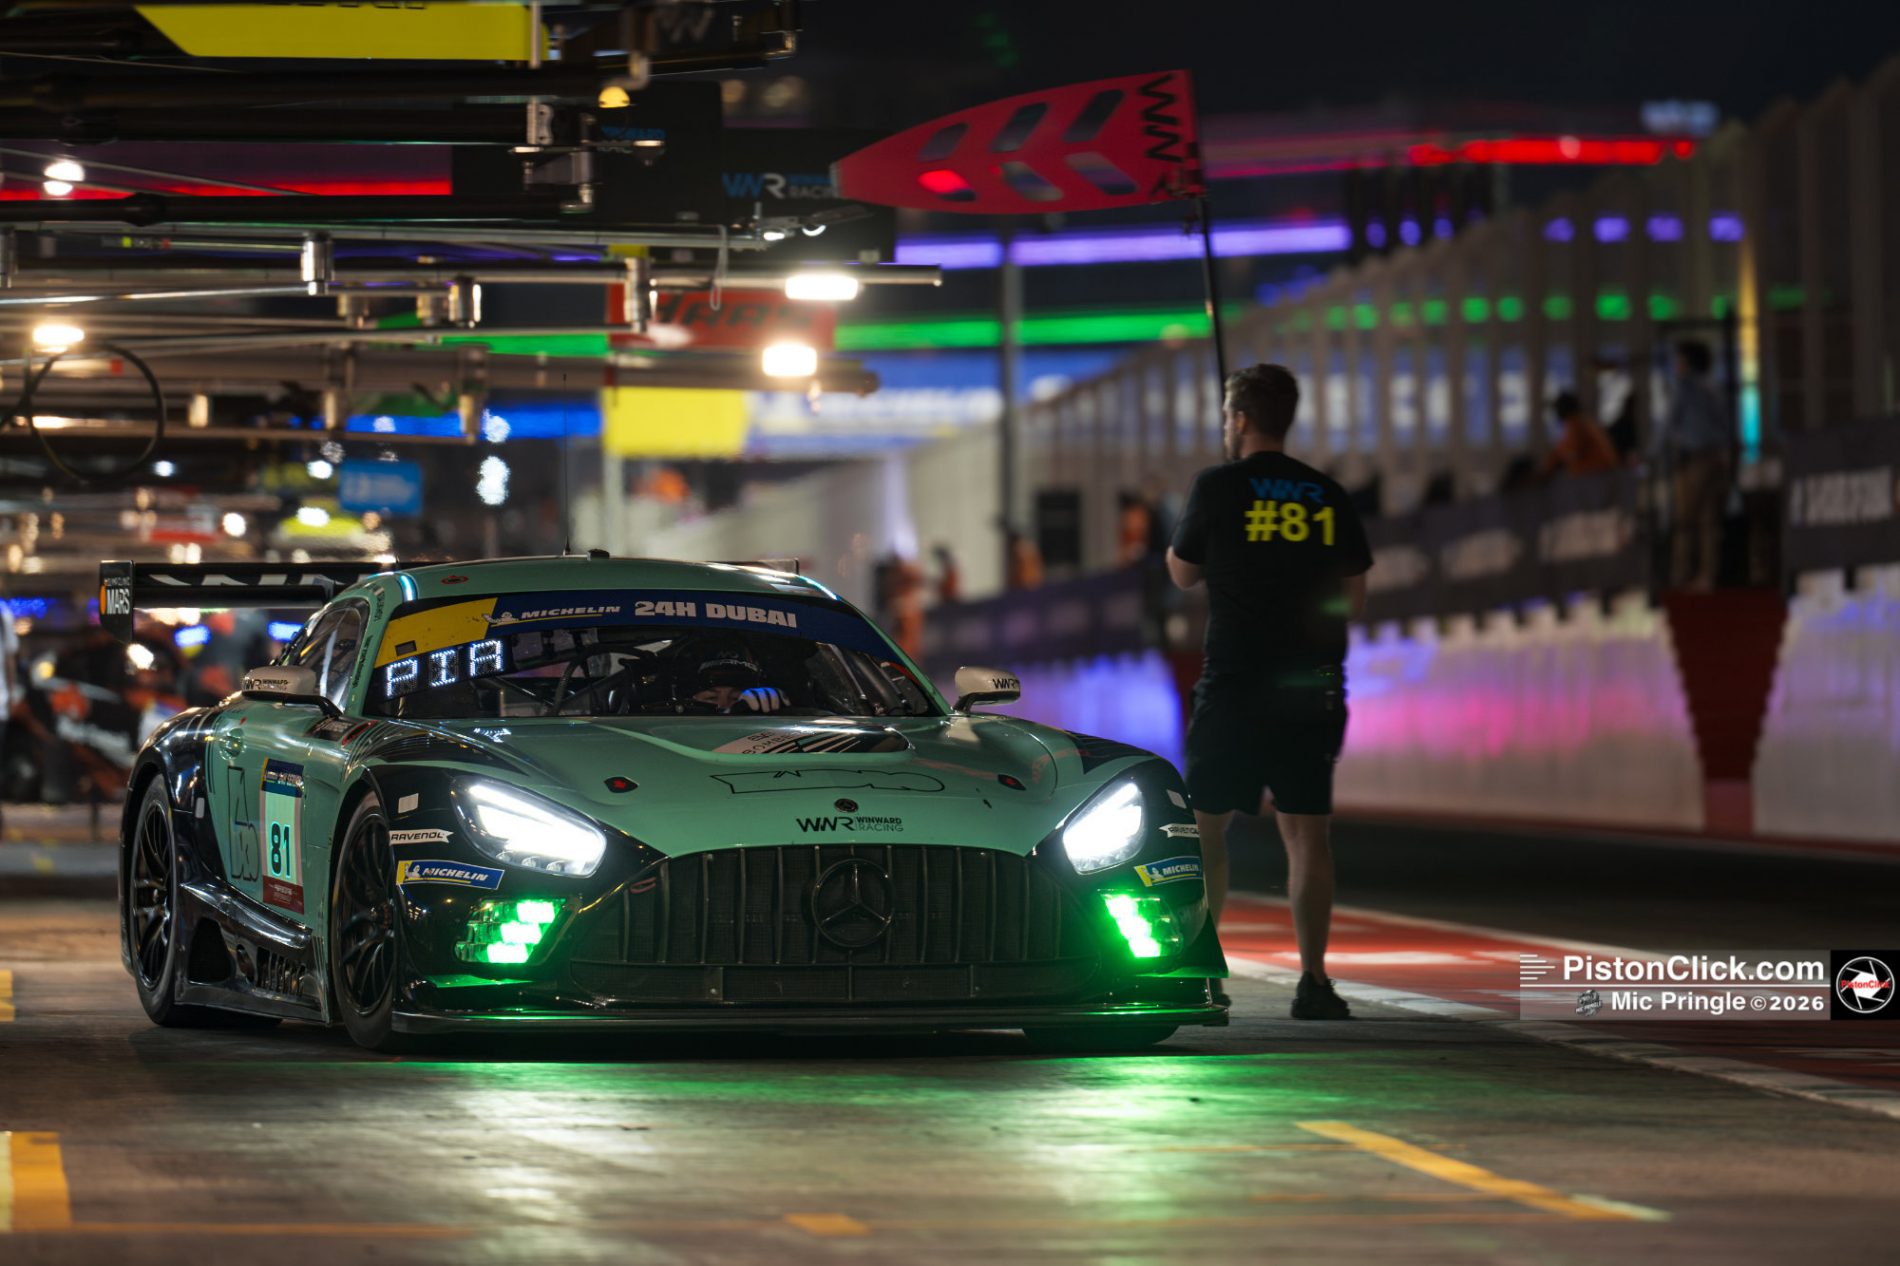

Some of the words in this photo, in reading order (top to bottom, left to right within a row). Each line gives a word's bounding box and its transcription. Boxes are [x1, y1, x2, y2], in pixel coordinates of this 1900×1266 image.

[1243, 500, 1336, 546] #81
[106, 588, 131, 615] MARS
[521, 605, 620, 620] MICHELIN
[634, 601, 696, 617] 24H
[704, 603, 797, 628] DUBAI
[856, 816, 902, 824] WINWARD
[860, 823, 904, 832] RACING
[391, 831, 444, 841] RAVENOL
[270, 822, 291, 877] 81
[422, 867, 489, 881] MICHELIN
